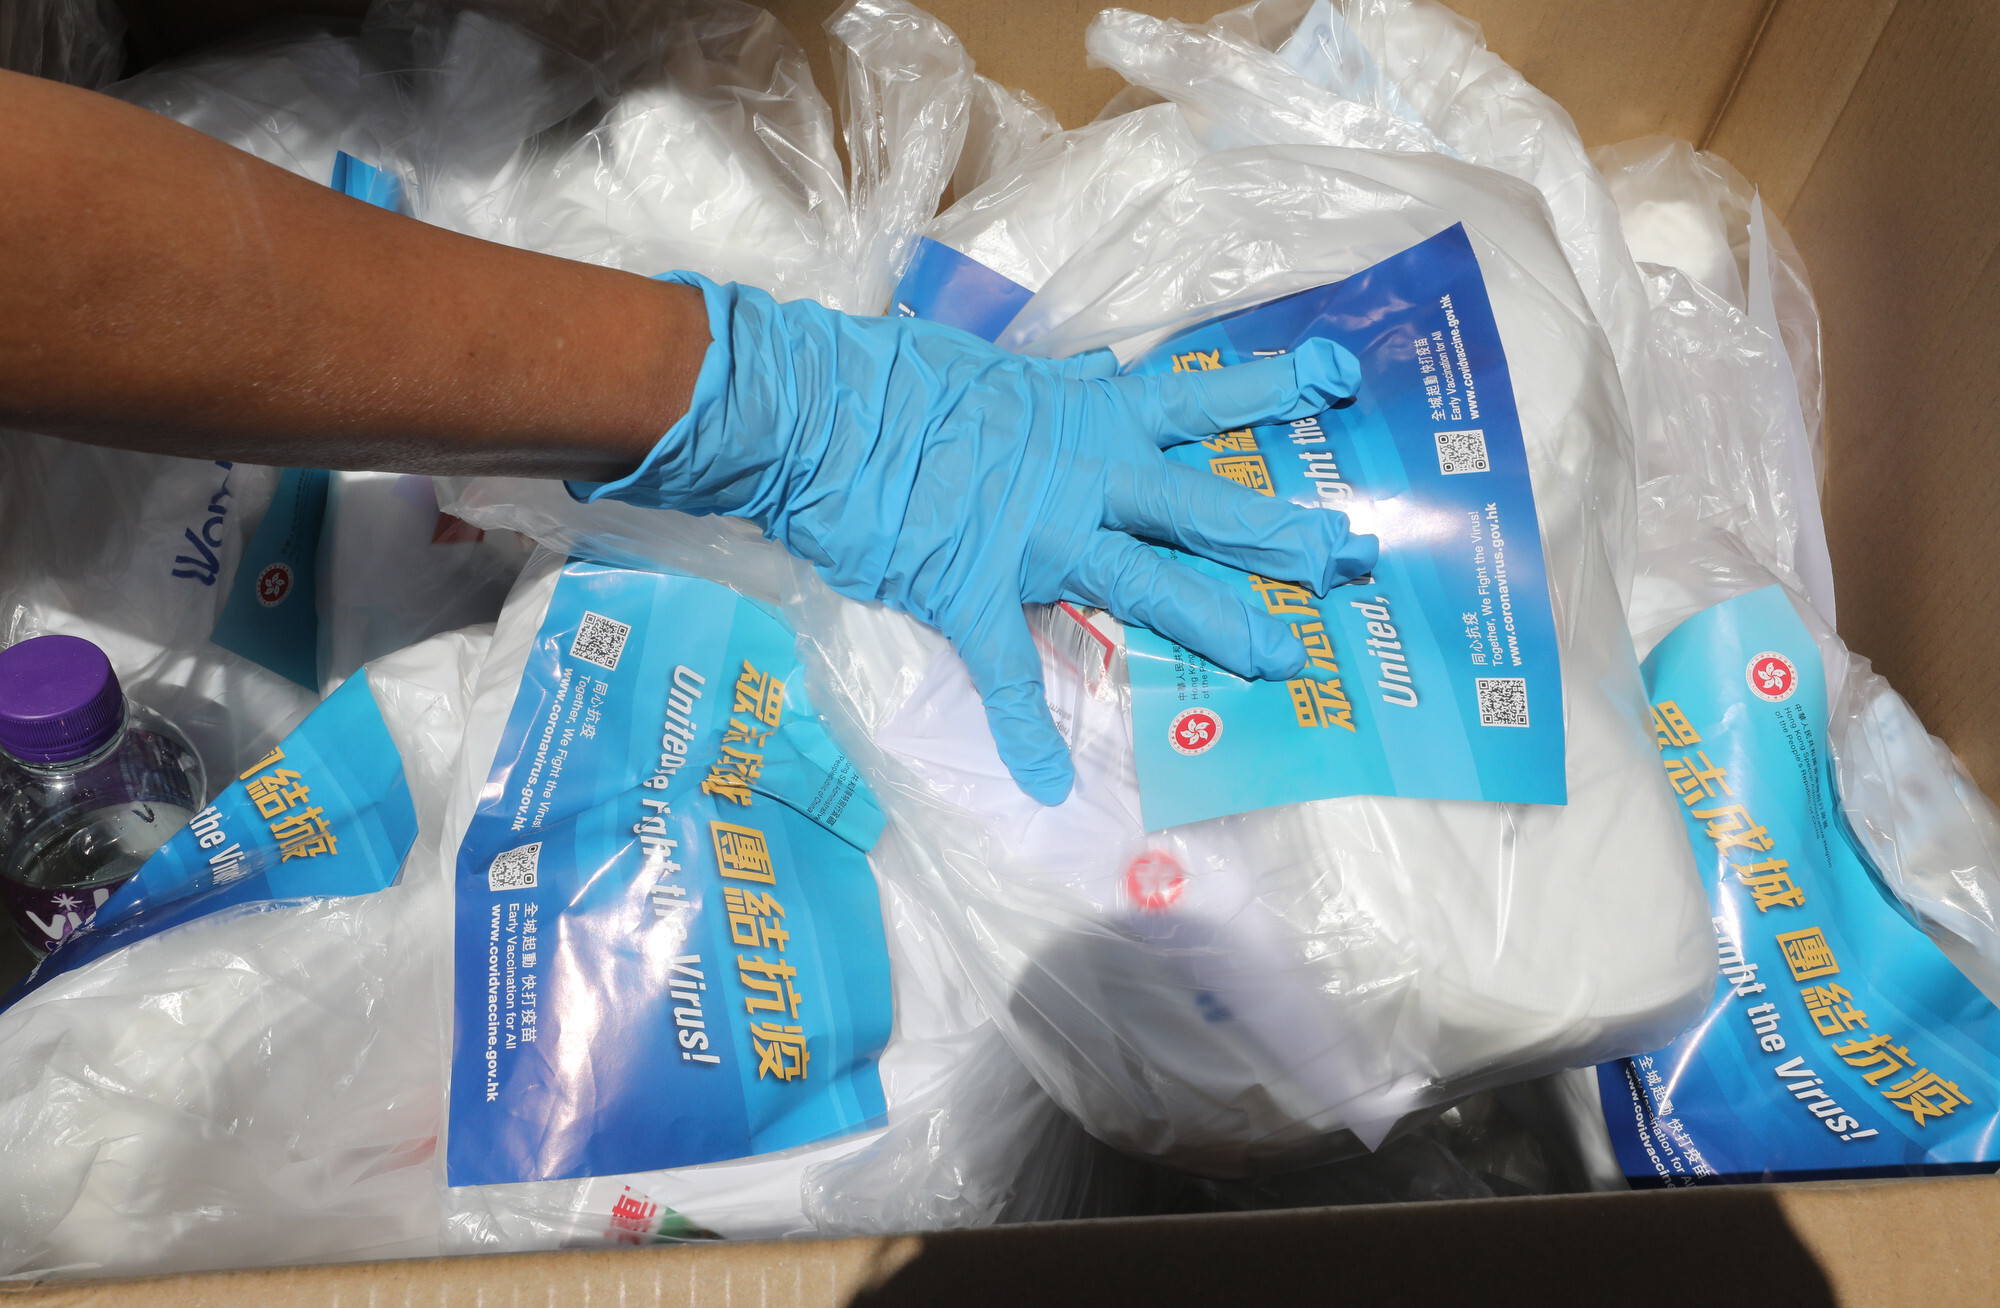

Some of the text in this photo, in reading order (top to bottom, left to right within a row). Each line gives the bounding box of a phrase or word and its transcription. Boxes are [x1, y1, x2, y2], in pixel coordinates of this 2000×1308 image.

[1423, 375, 1446, 421] 全城起動
[1439, 352, 1457, 395] Vaccination
[1440, 293, 1480, 420] www.covidvaccine.gov.hk
[1449, 396, 1462, 421] Early
[1462, 611, 1489, 666] 同心抗疫
[1468, 511, 1504, 667] Together, We Fight the Virus!
[1485, 502, 1523, 667] www.coronavirus.gov.hk
[1350, 596, 1419, 708] United,
[511, 668, 574, 831] www.coronavirus.gov.hk
[532, 675, 591, 828] Together, We Fight the Virus!
[579, 680, 608, 740] 同心抗疫
[1775, 710, 1783, 719] of
[1779, 720, 1788, 733] the
[1786, 734, 1803, 768] People's
[1784, 707, 1797, 729] Hong
[1794, 730, 1806, 751] Kong
[189, 805, 226, 849] the
[486, 903, 501, 1103] www.covidvaccine.gov.hk
[505, 902, 520, 1049] Early Vaccination for All
[521, 902, 539, 1043] 全城起動 快打疫苗
[710, 820, 811, 1082] 團結抗疫
[667, 954, 721, 1064] Virus!
[1776, 926, 1974, 1128] 團結抗疫
[1747, 1002, 1786, 1052] the
[1774, 1056, 1879, 1141] Virus!
[1666, 1118, 1711, 1179] 快打疫苗
[1671, 1157, 1686, 1173] for
